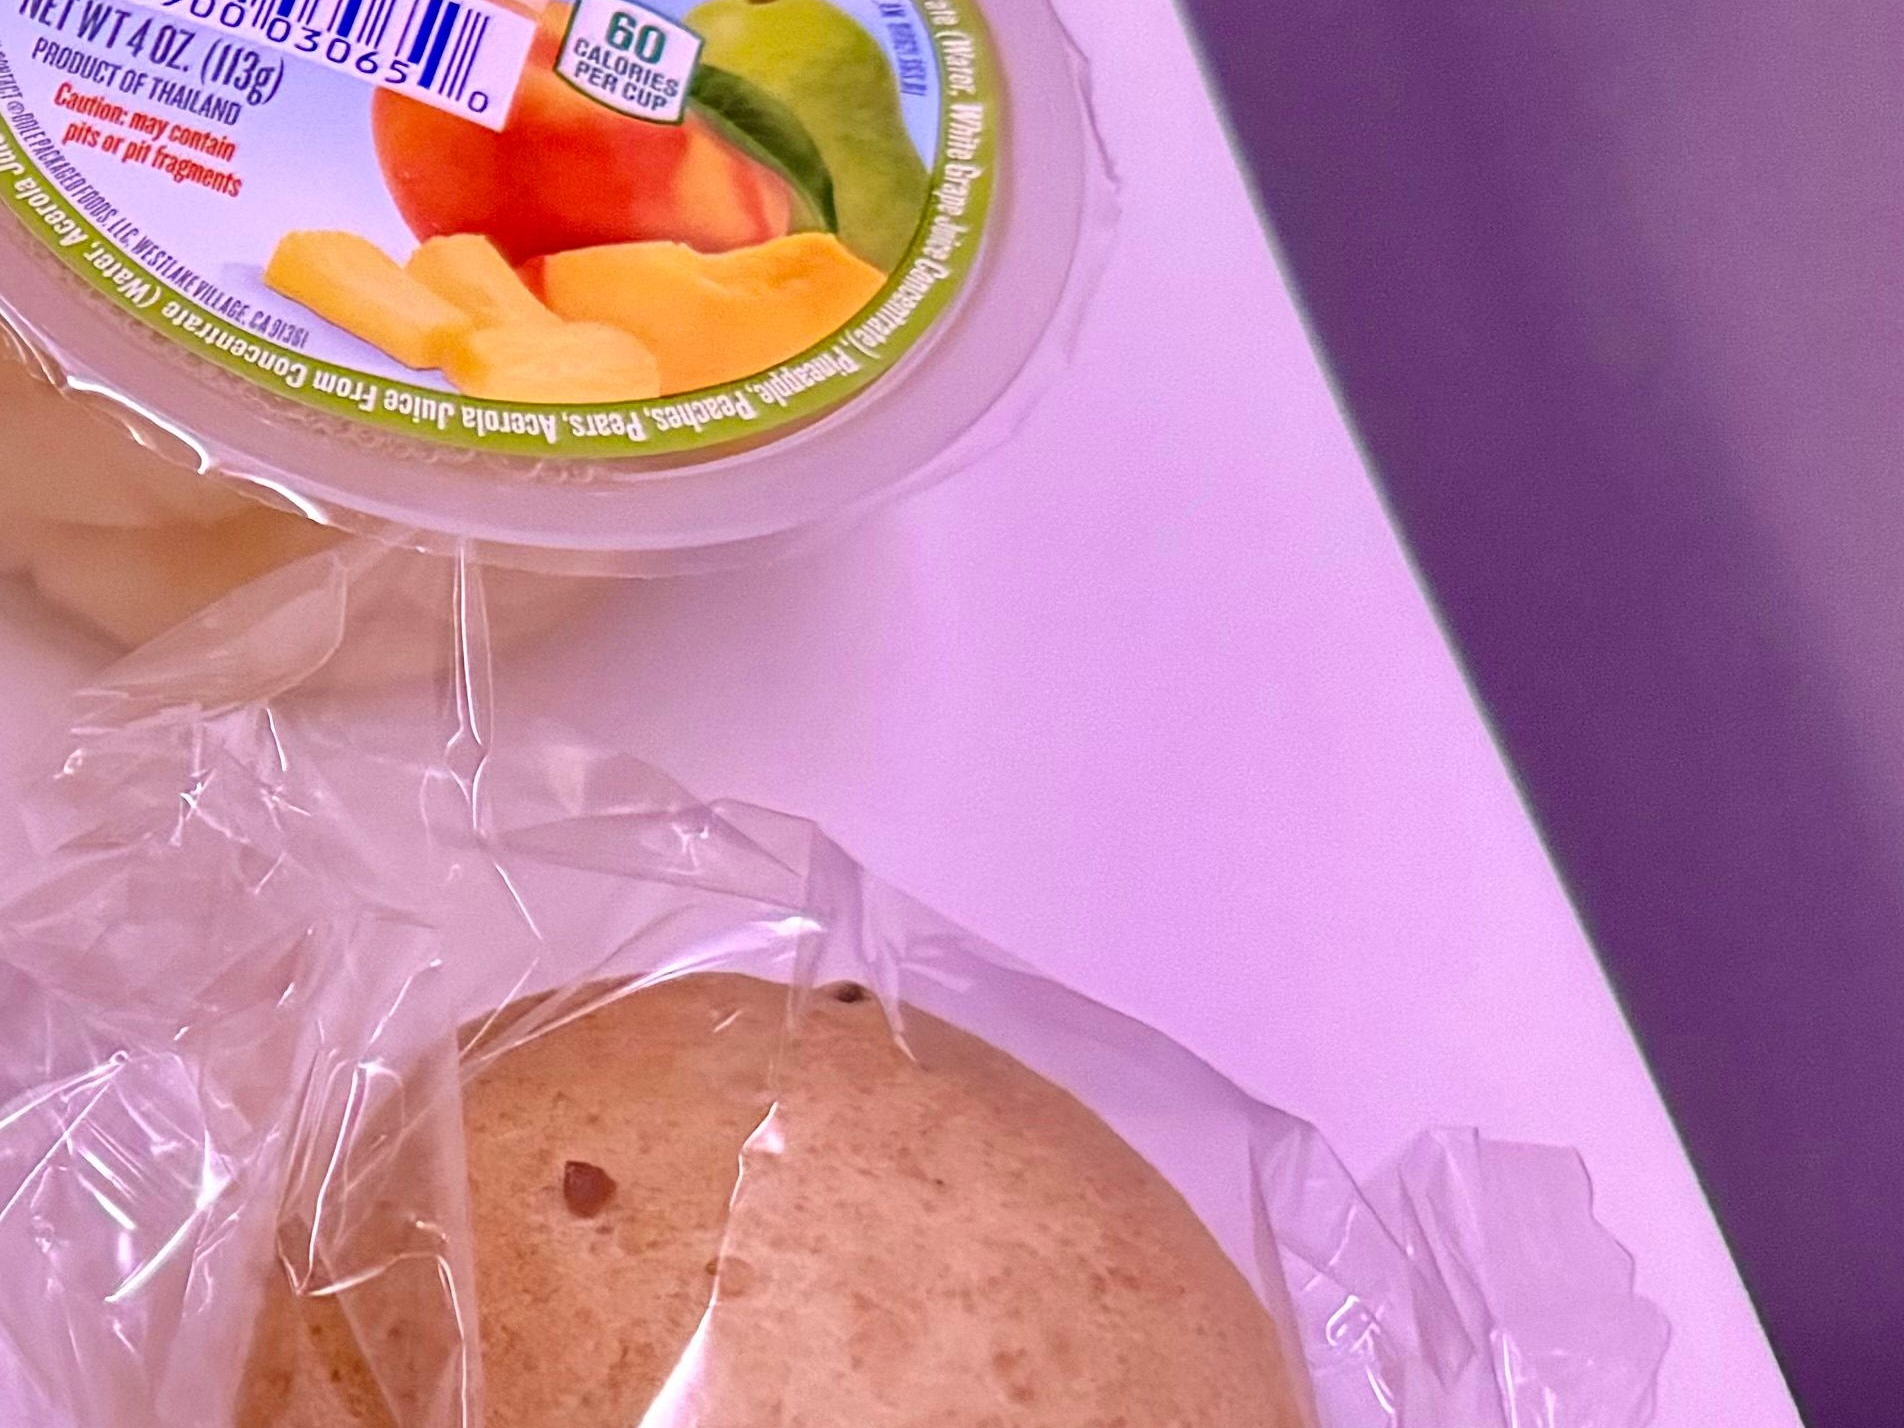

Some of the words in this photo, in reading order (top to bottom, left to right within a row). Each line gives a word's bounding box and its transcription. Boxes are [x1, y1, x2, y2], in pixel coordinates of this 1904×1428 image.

[126, 18, 153, 59] 4
[149, 25, 192, 73] OZ.
[201, 38, 286, 106] (113g)
[267, 16, 412, 86] 03065
[468, 90, 489, 114] 0
[573, 37, 680, 98] CALORIES
[606, 10, 667, 65] 60
[32, 37, 122, 86] PRODUCT
[122, 64, 149, 96] OF
[149, 75, 244, 126] THAILAND
[574, 60, 619, 94] PER
[621, 80, 668, 112] CUP
[54, 81, 128, 127] Caution:
[129, 107, 170, 139] may
[168, 118, 236, 162] contain
[946, 101, 984, 160] White
[62, 119, 101, 150] pits
[101, 132, 125, 157] or
[120, 135, 151, 164] pit
[151, 145, 245, 198] fragments
[934, 160, 981, 216] Grape
[14, 176, 88, 246] Acerola
[28, 137, 86, 192] PACKAGED
[130, 235, 200, 292] WESTLAKE
[247, 309, 272, 334] CA
[922, 214, 967, 261] Juice
[83, 241, 161, 308] (Water,
[161, 300, 308, 388] Concentrate
[311, 369, 378, 412] From
[745, 345, 861, 406] Pineapple,
[382, 388, 456, 430] Juice
[460, 405, 558, 444] Acerola
[561, 410, 648, 442] Pears,
[643, 390, 758, 432] Peaches,
